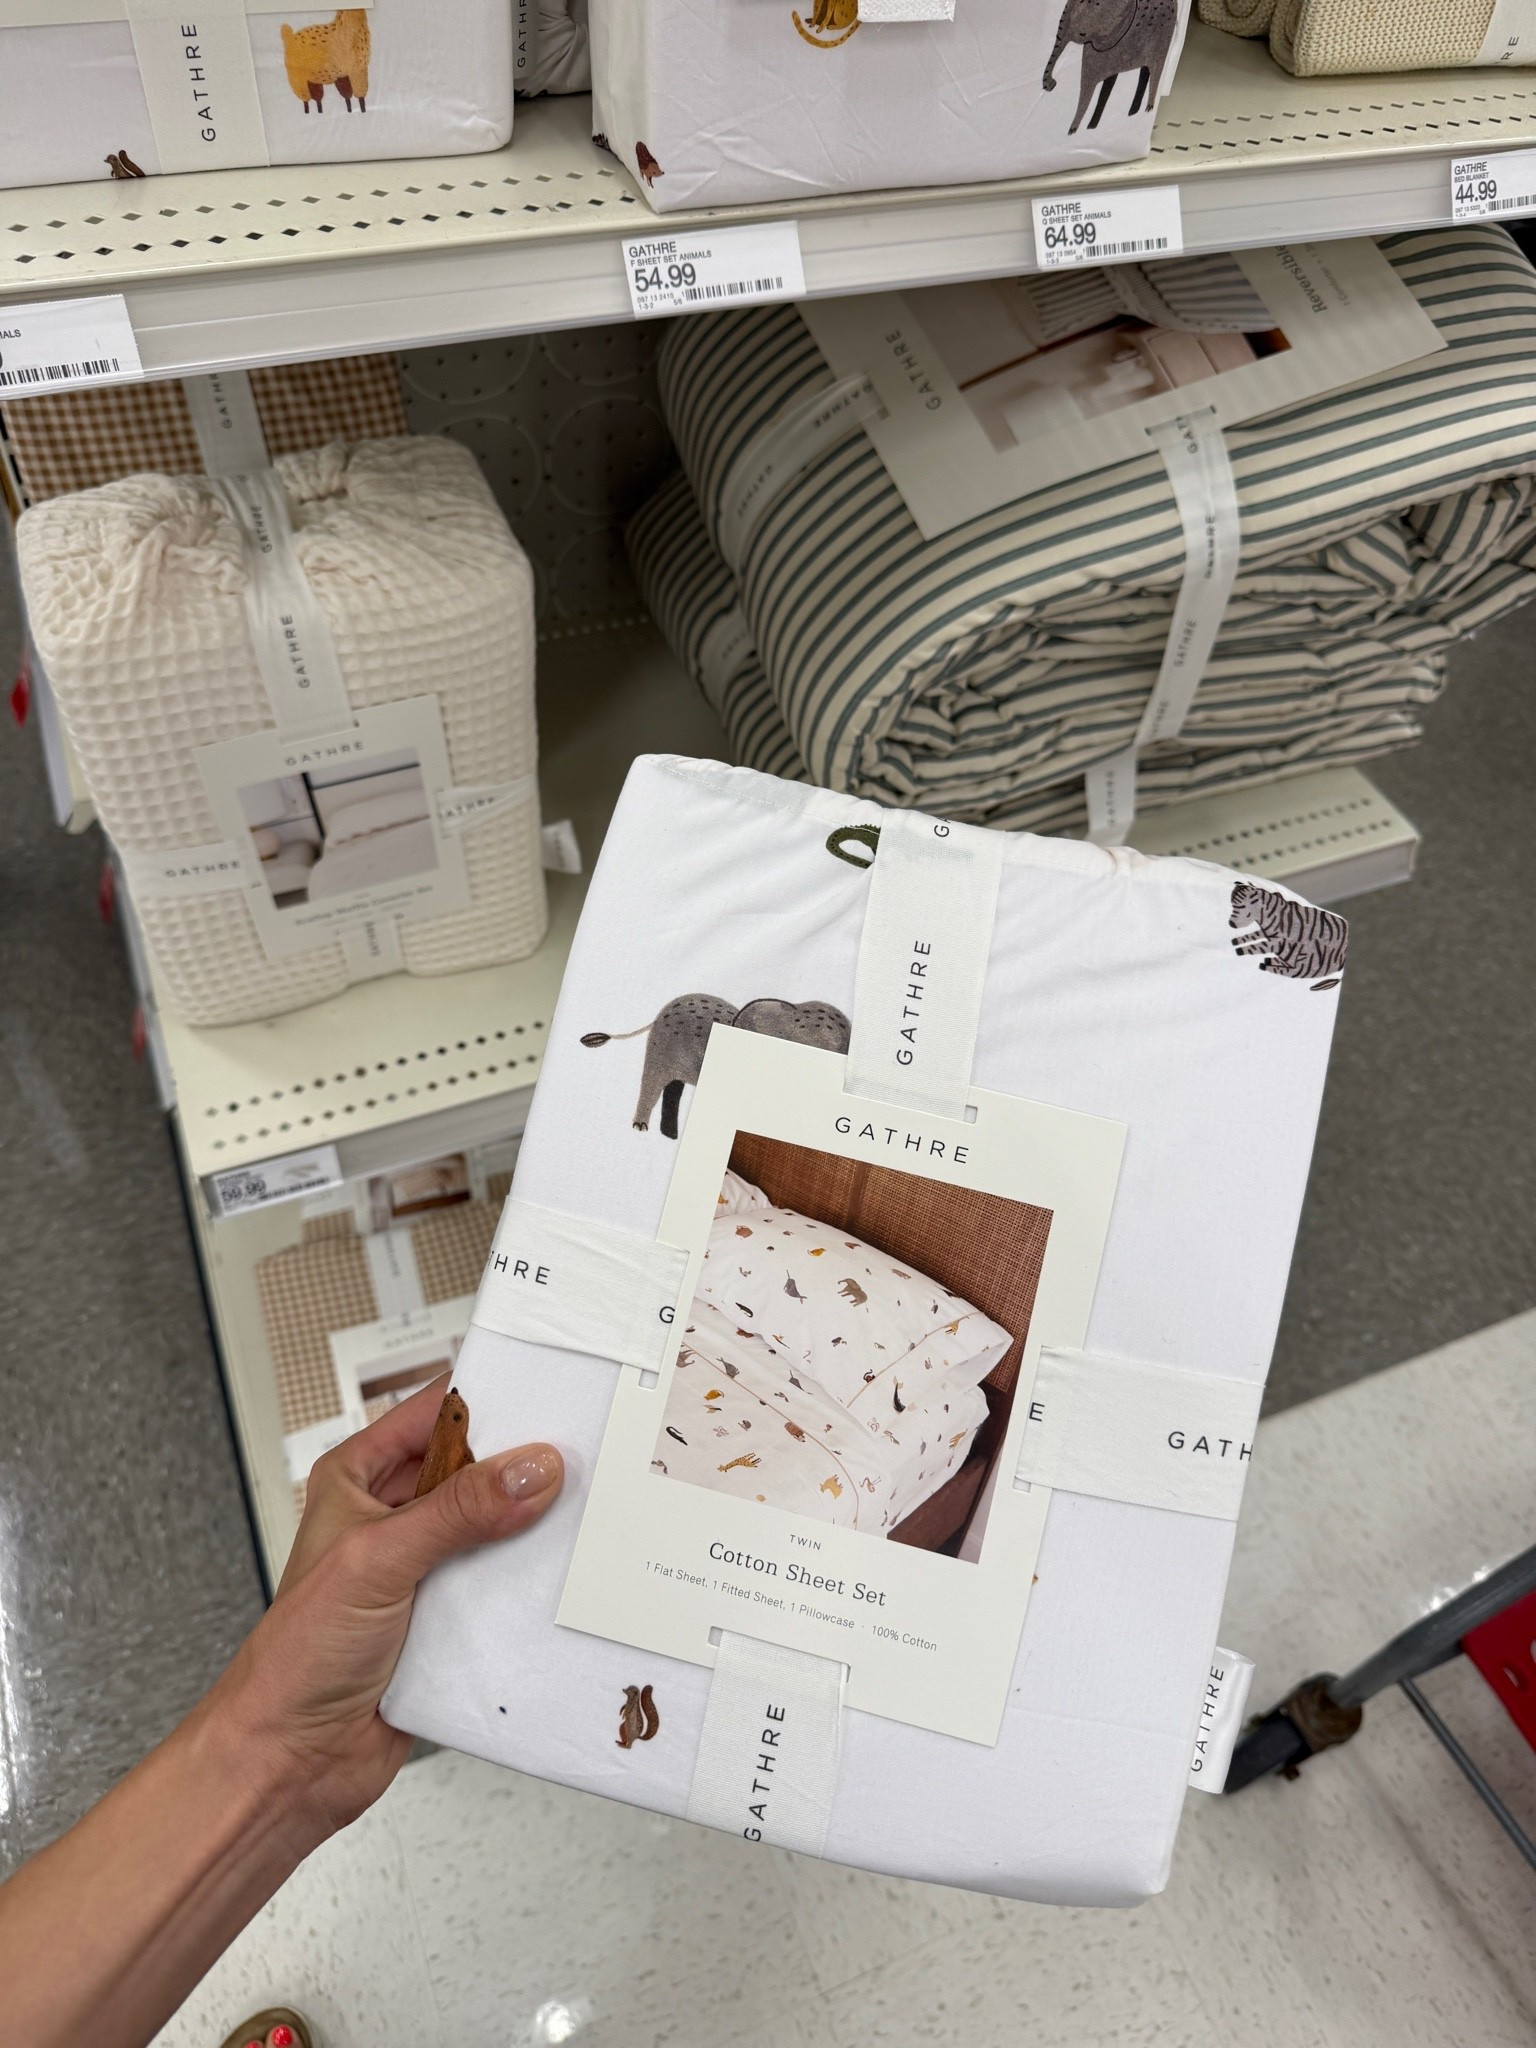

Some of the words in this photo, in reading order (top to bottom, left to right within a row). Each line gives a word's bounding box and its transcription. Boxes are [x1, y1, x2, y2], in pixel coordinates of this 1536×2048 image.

[181, 24, 216, 142] GATHRE
[1454, 161, 1488, 175] GATHRE
[1466, 171, 1490, 182] BLANKET
[1455, 179, 1497, 204] 44.99
[1041, 202, 1082, 217] GATHRE
[1042, 218, 1048, 226] Q
[1049, 215, 1069, 225] SHEET
[1071, 214, 1082, 223] SET
[1084, 211, 1112, 221] ANIMALS
[1044, 222, 1096, 248] 64.99
[628, 241, 677, 258] GATHRE
[630, 259, 636, 267] F
[637, 256, 661, 267] SHEET
[663, 253, 677, 264] SET
[679, 250, 712, 261] ANIMALS
[634, 262, 697, 293] 54.99
[884, 329, 942, 411] GATHRE
[280, 614, 311, 689] GATHRE
[284, 740, 365, 767] GATHRE
[165, 860, 241, 878] GATHRE
[896, 939, 931, 1067] GATHRE
[835, 1116, 970, 1165] GATHRE
[789, 1534, 823, 1551] TWIN
[708, 1541, 779, 1577] Cotton
[785, 1563, 846, 1596] Sheet
[852, 1582, 887, 1607] Set
[646, 1561, 651, 1570] 1
[654, 1563, 673, 1578] Flat
[675, 1569, 708, 1588] Sheet,
[713, 1580, 718, 1590] 1
[721, 1582, 751, 1599] Fitted
[753, 1591, 786, 1610] Sheet,
[790, 1602, 796, 1612] 1
[799, 1604, 855, 1629] Pillowcase
[872, 1625, 899, 1641] 100%
[902, 1633, 938, 1652] Cotton
[743, 1704, 786, 1842] GATHRE
